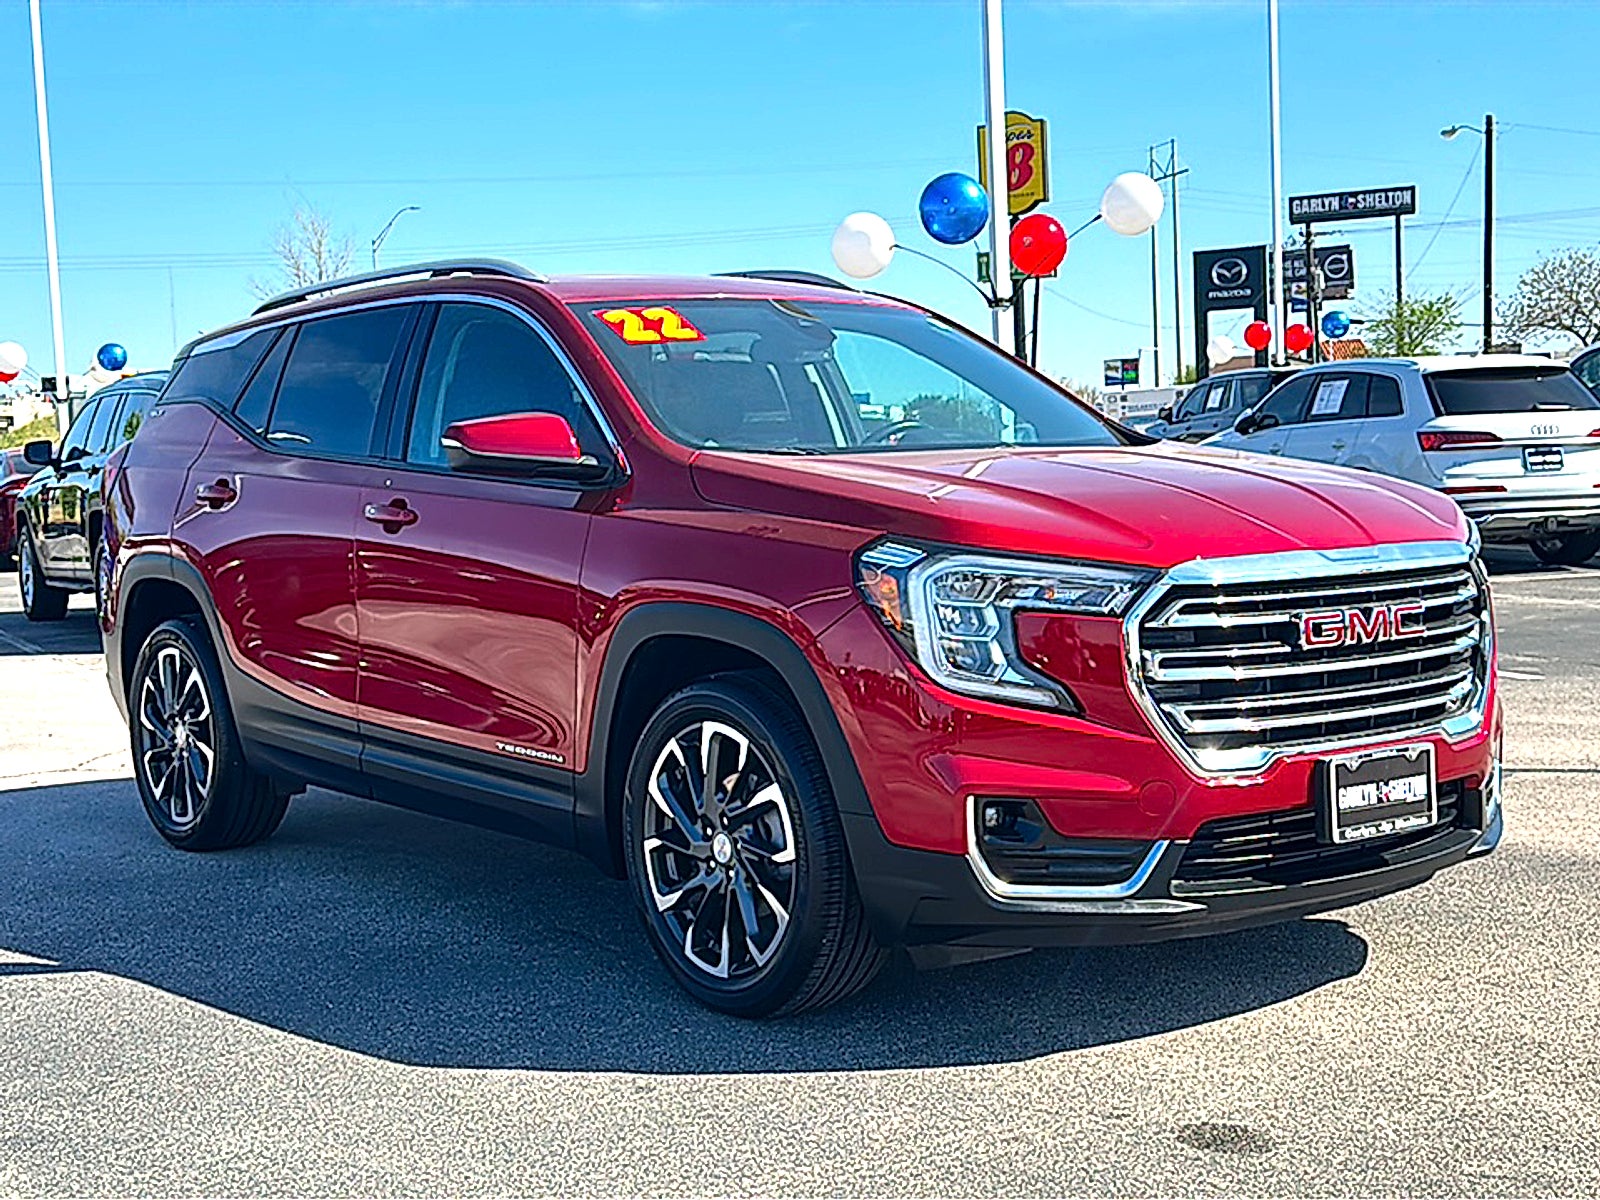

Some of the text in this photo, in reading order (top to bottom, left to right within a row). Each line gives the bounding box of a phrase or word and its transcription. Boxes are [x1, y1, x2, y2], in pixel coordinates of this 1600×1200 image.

[1291, 189, 1413, 215] GARLYN SHELTON
[602, 307, 700, 342] 22
[1303, 604, 1426, 649] GMC
